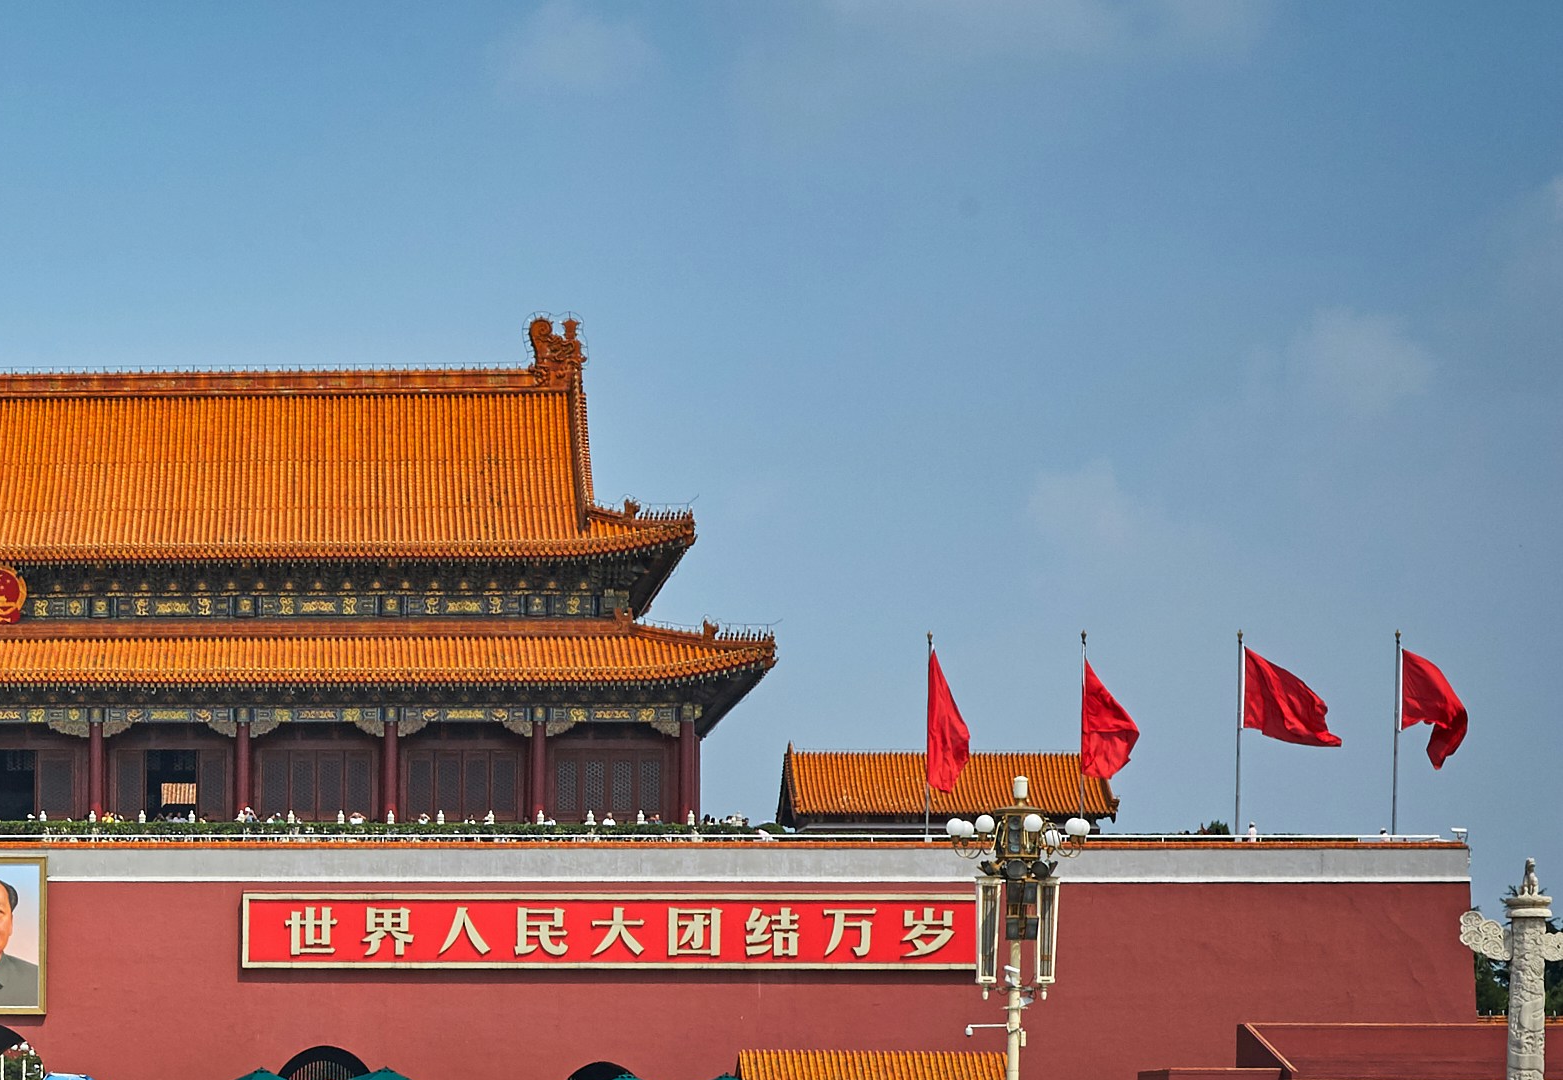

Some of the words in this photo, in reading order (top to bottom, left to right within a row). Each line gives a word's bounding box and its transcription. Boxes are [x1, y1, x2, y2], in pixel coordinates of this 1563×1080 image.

[284, 906, 956, 957] 世界人民大团结万岁
